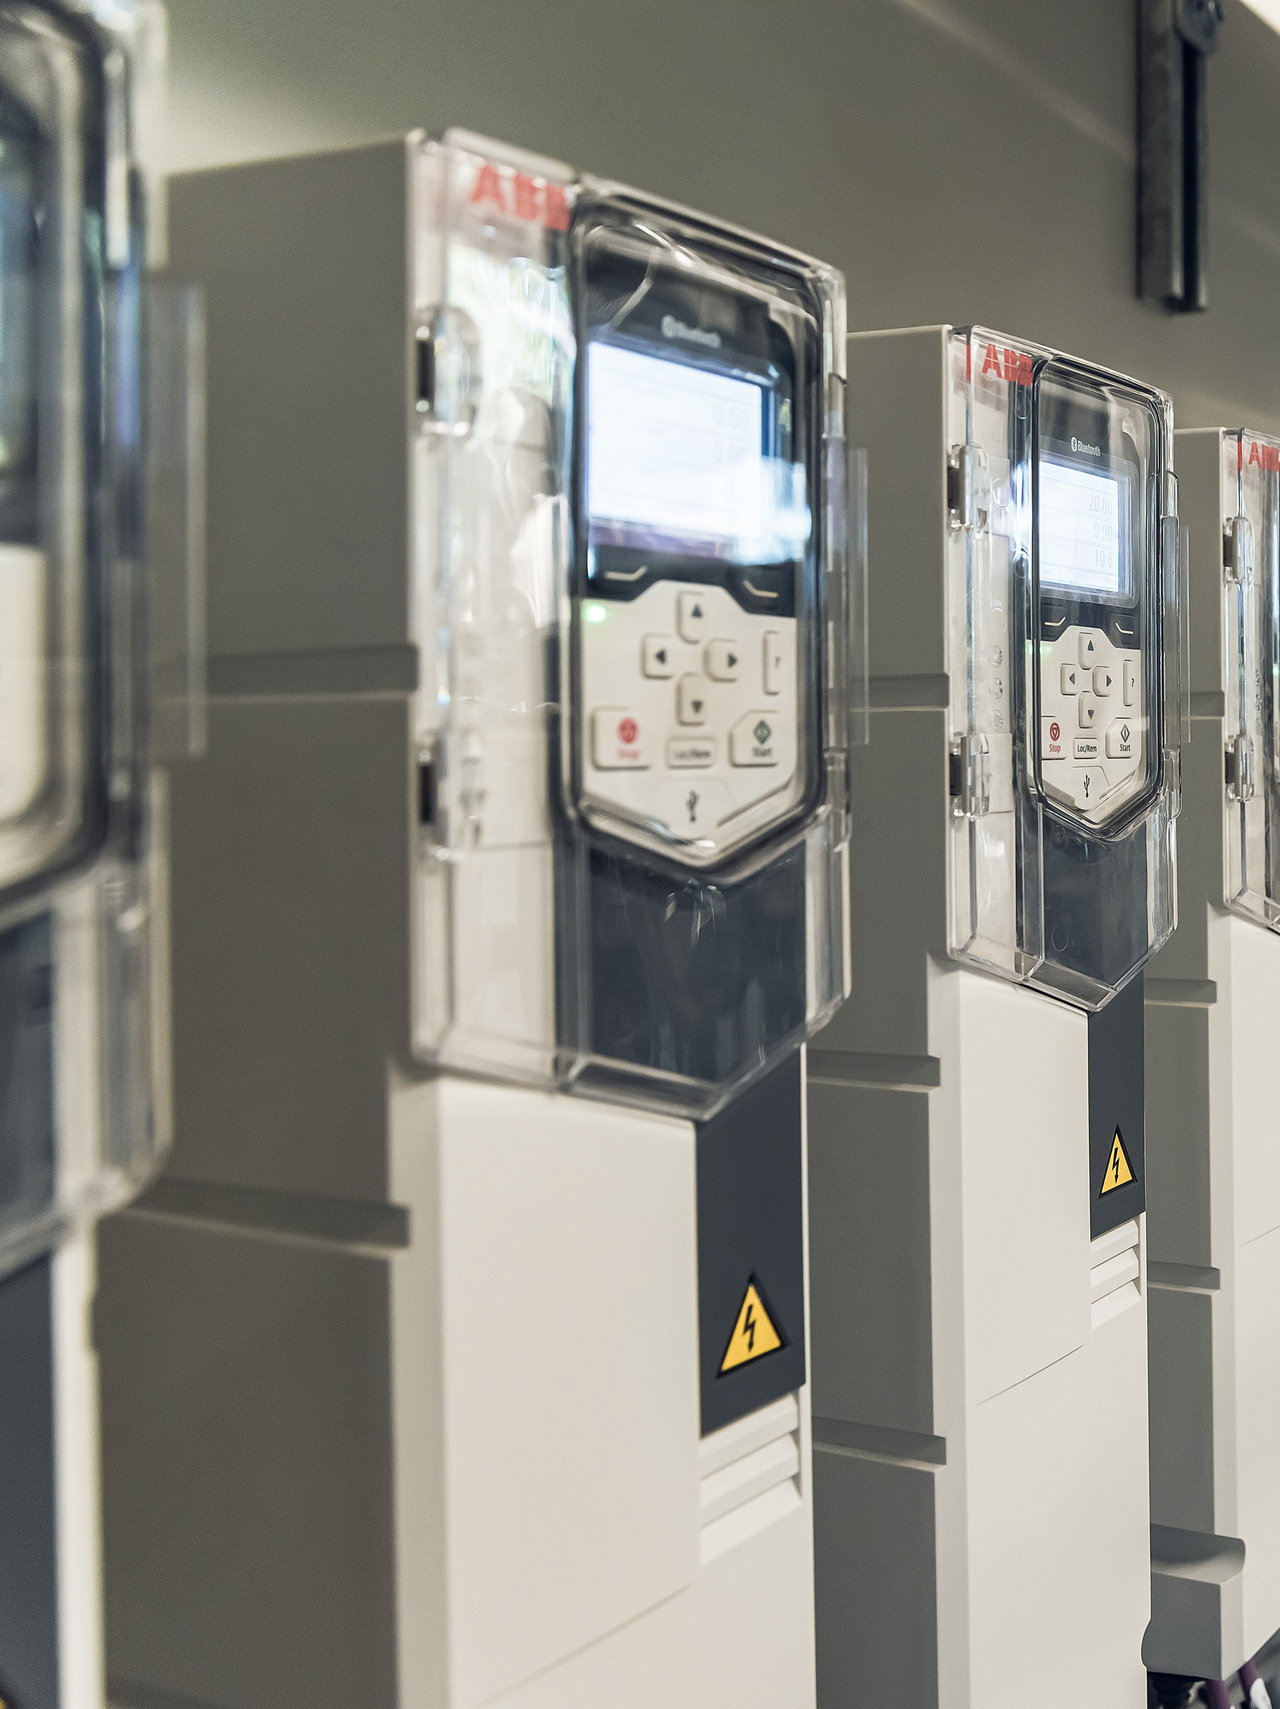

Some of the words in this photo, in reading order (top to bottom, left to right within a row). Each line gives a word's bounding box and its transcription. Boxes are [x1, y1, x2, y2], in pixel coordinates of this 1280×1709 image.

[982, 344, 1033, 387] ABB
[1088, 494, 1113, 515] 20.00
[1094, 522, 1113, 542] 9.90
[1094, 549, 1113, 569] 10.8
[1049, 744, 1061, 754] Stop
[1077, 744, 1098, 753] Loc/Rem
[1119, 743, 1131, 752] Start
